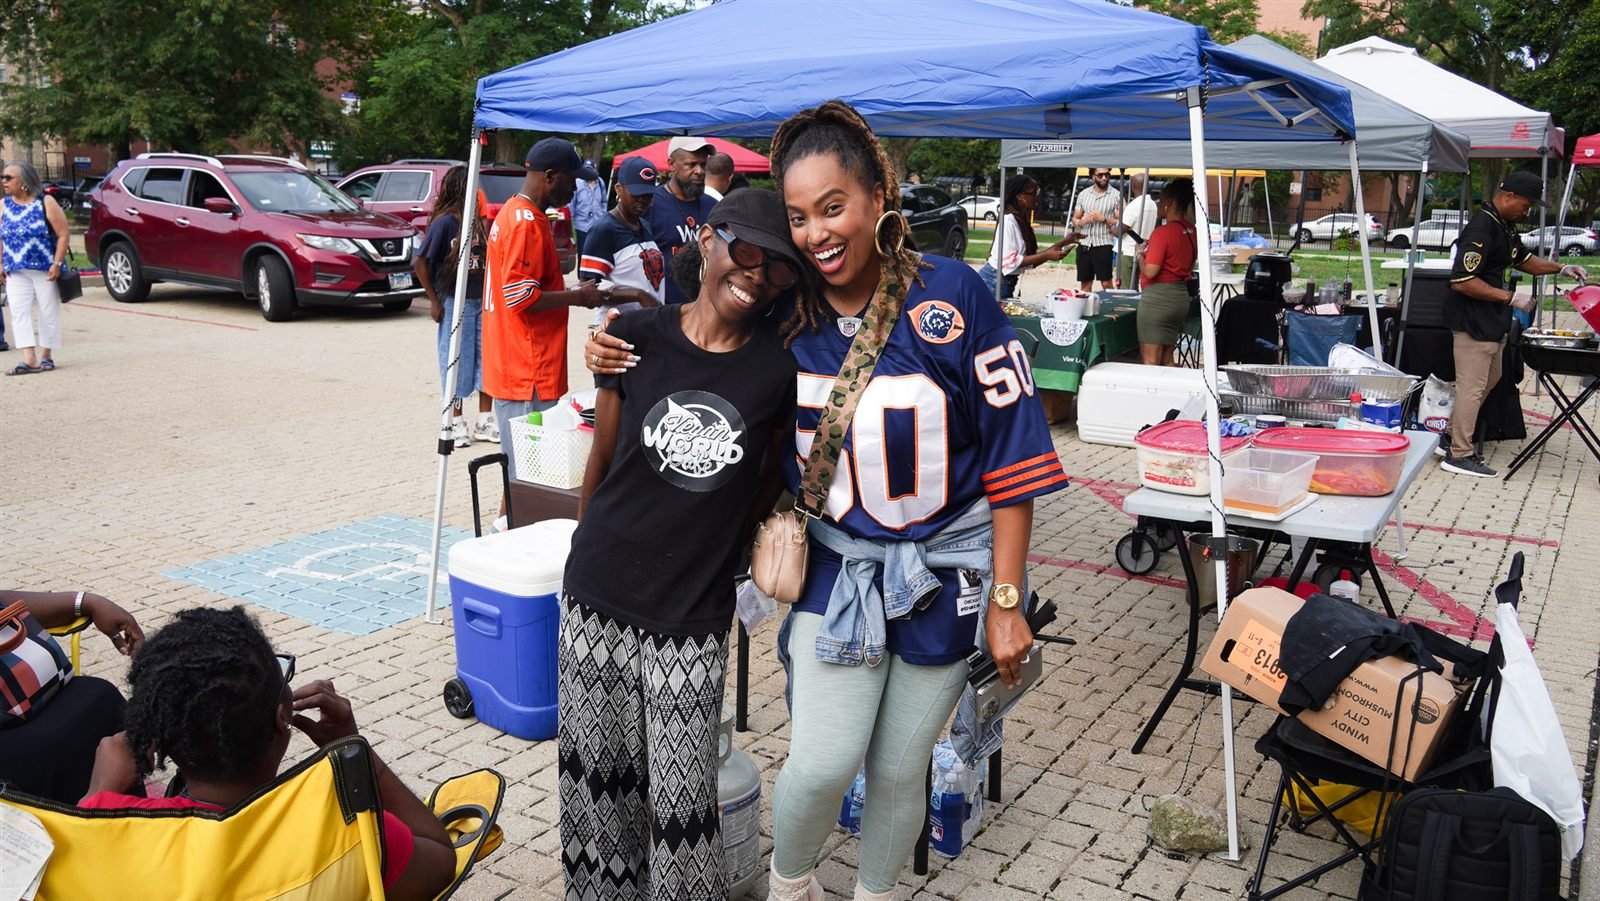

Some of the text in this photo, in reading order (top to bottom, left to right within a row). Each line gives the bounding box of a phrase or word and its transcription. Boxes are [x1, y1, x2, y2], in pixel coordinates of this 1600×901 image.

[1030, 143, 1071, 152] EVERBILT
[515, 209, 535, 222] 18
[974, 339, 1035, 409] 50
[666, 413, 730, 442] Vegan
[643, 425, 744, 465] WORLD
[795, 372, 949, 531] 50
[1337, 686, 1393, 719] MUSHROOM
[1331, 719, 1369, 744] WINDY
[1344, 709, 1370, 726] CITY
